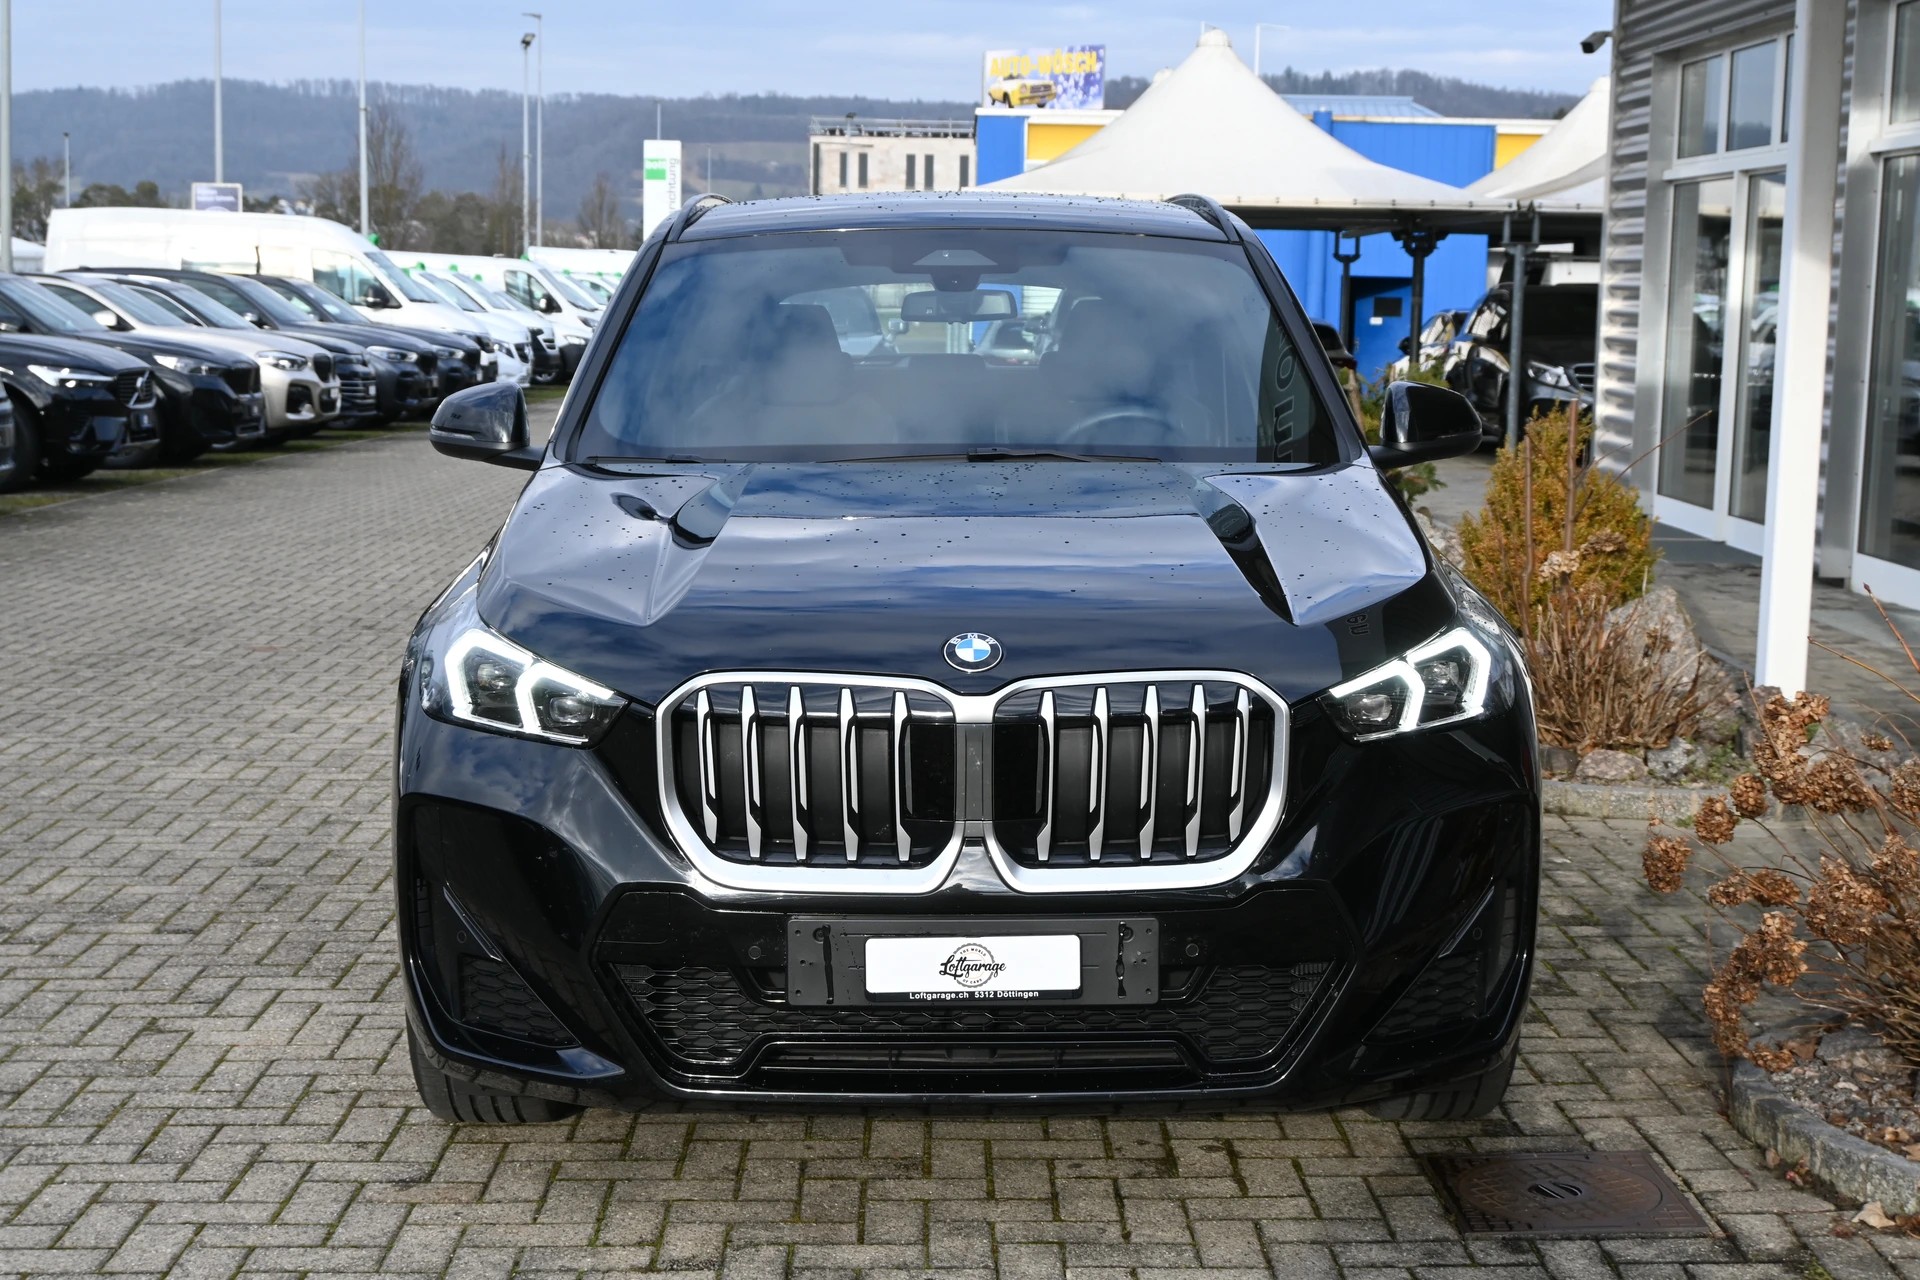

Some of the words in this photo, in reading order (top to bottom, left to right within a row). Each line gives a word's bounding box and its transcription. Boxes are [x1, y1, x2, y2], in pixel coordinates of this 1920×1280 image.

[949, 633, 997, 645] BMW
[939, 954, 1007, 981] Loftgarage
[909, 991, 969, 1000] Loftgarage.ch
[974, 990, 995, 998] 5312
[997, 990, 1039, 1000] Döttingen
